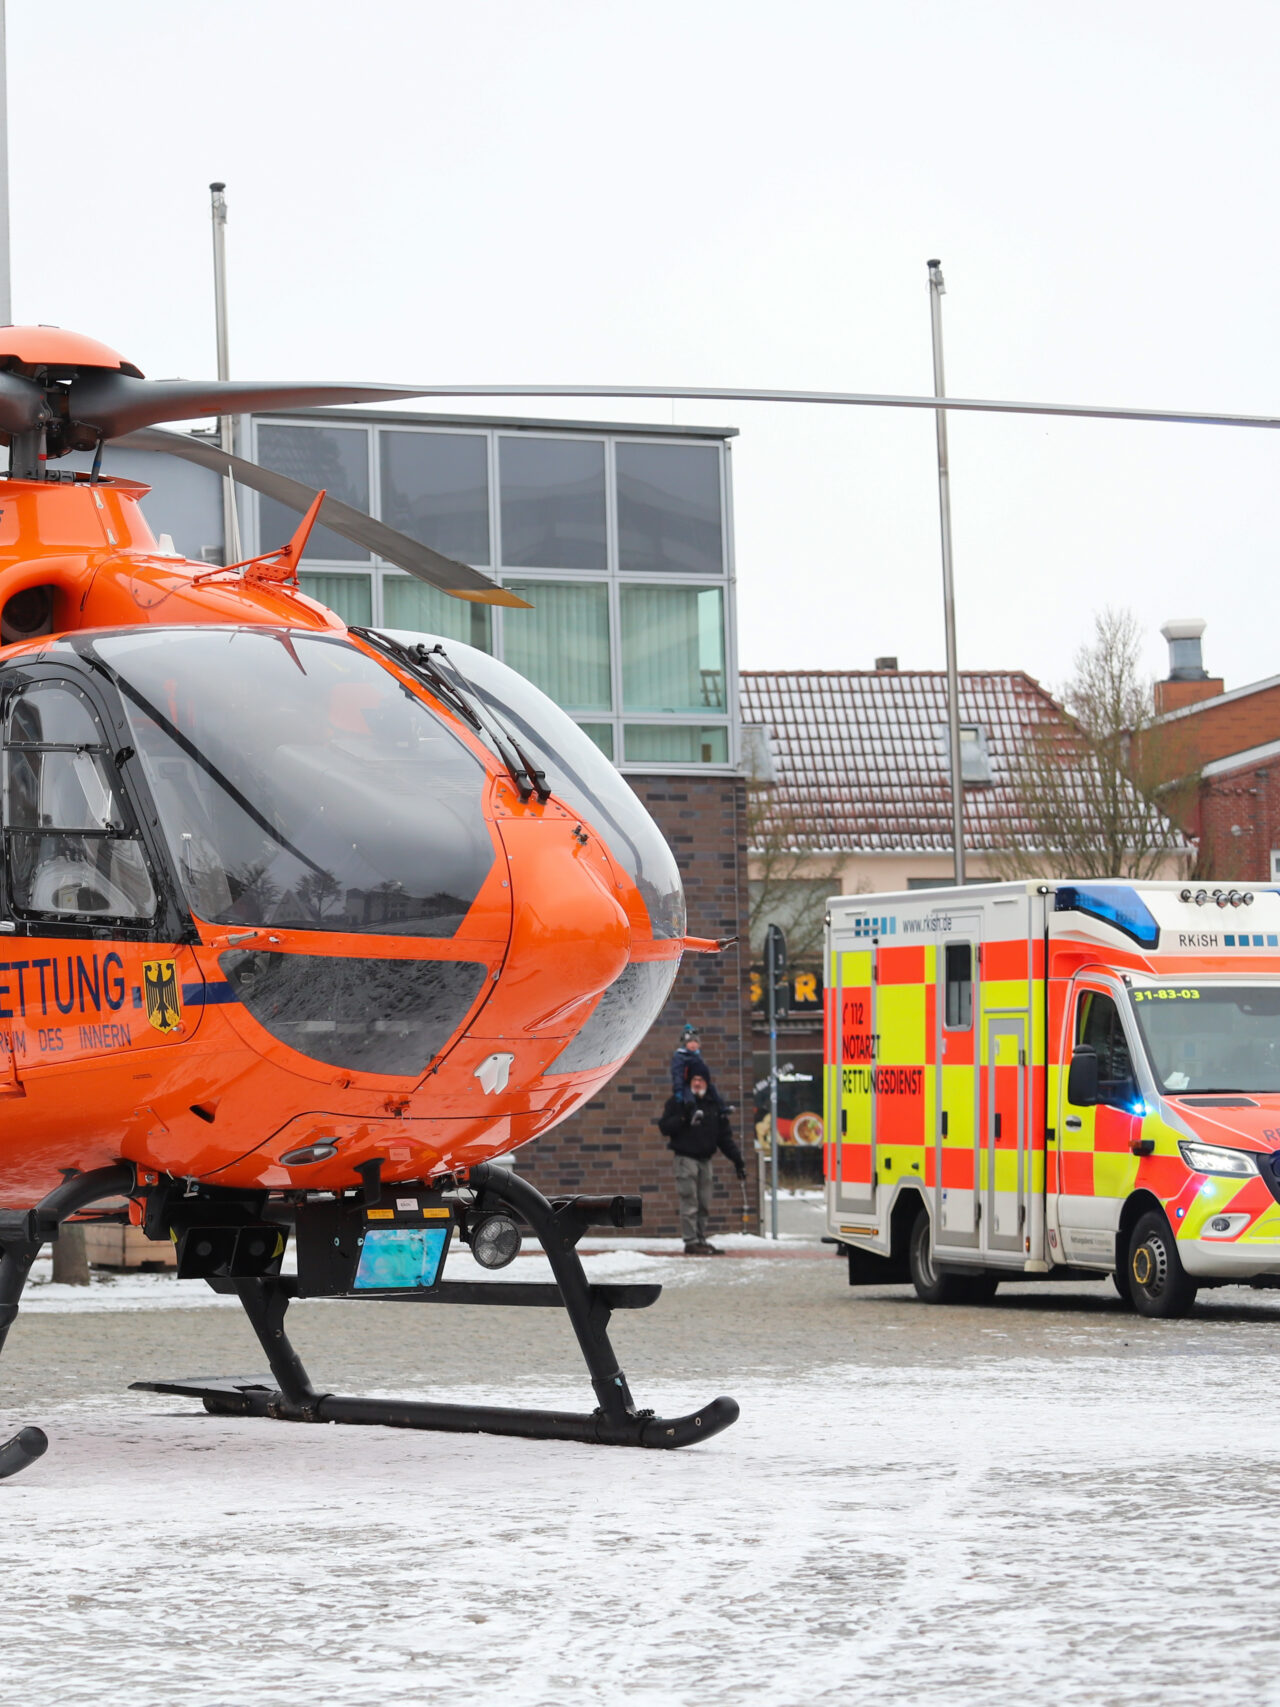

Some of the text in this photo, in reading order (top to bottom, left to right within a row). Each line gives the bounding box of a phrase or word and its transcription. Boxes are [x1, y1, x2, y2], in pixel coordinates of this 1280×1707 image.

[902, 915, 952, 933] www.rkish.de
[1133, 989, 1200, 1001] 31-83-03
[850, 1003, 863, 1025] 112
[38, 1028, 64, 1052] DES
[79, 1023, 132, 1049] INNERN
[842, 1034, 880, 1060] NOTARZT
[842, 1068, 923, 1096] RETTUNGSDIENST
